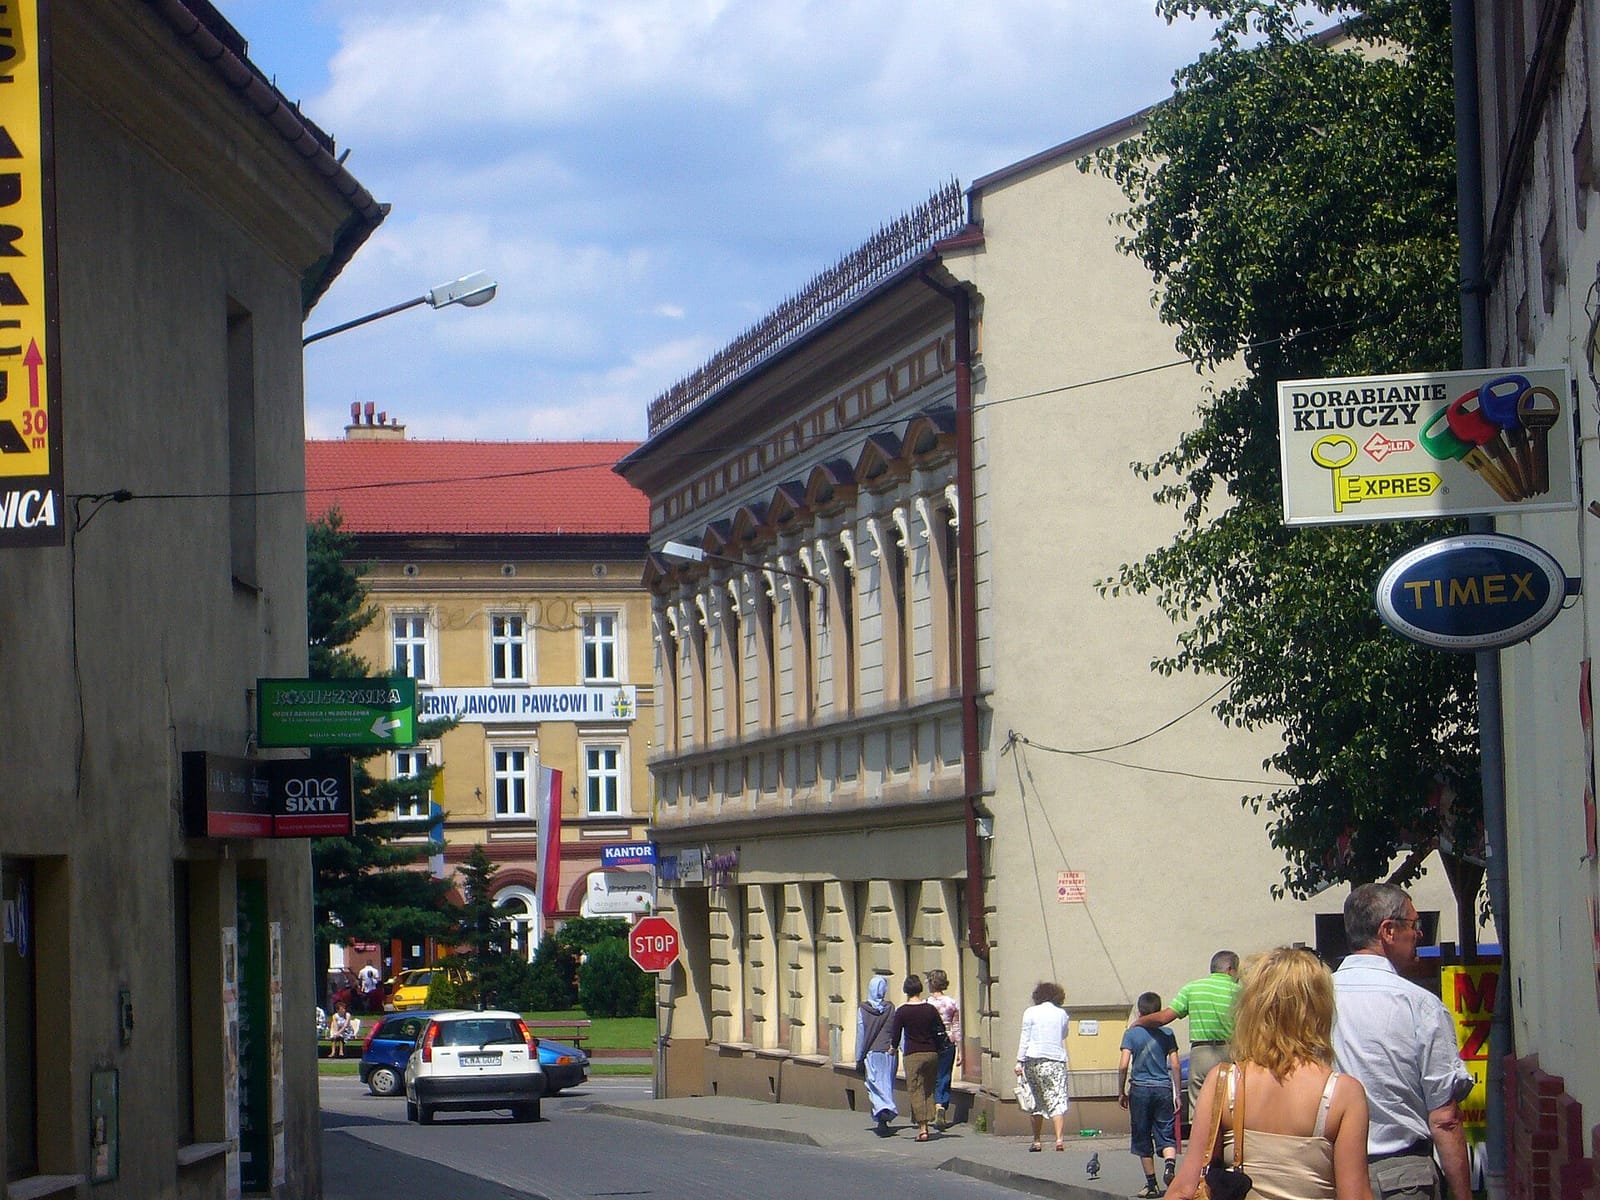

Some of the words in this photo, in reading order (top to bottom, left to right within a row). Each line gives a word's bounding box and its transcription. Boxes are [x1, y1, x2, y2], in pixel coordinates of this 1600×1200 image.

[1292, 384, 1447, 409] DORABIANIE
[22, 410, 47, 435] 30
[1293, 404, 1420, 431] KLUCZY
[32, 437, 45, 449] m
[1348, 475, 1431, 502] EXPRES
[1404, 572, 1536, 610] TIMEX
[423, 695, 458, 714] ERNY
[463, 695, 516, 714] JANOWI
[522, 694, 588, 713] PAWŁOWI
[593, 694, 603, 712] II
[285, 777, 338, 798] one
[285, 797, 339, 812] SIXTY
[605, 846, 652, 858] KANTOR
[635, 935, 674, 953] STOP
